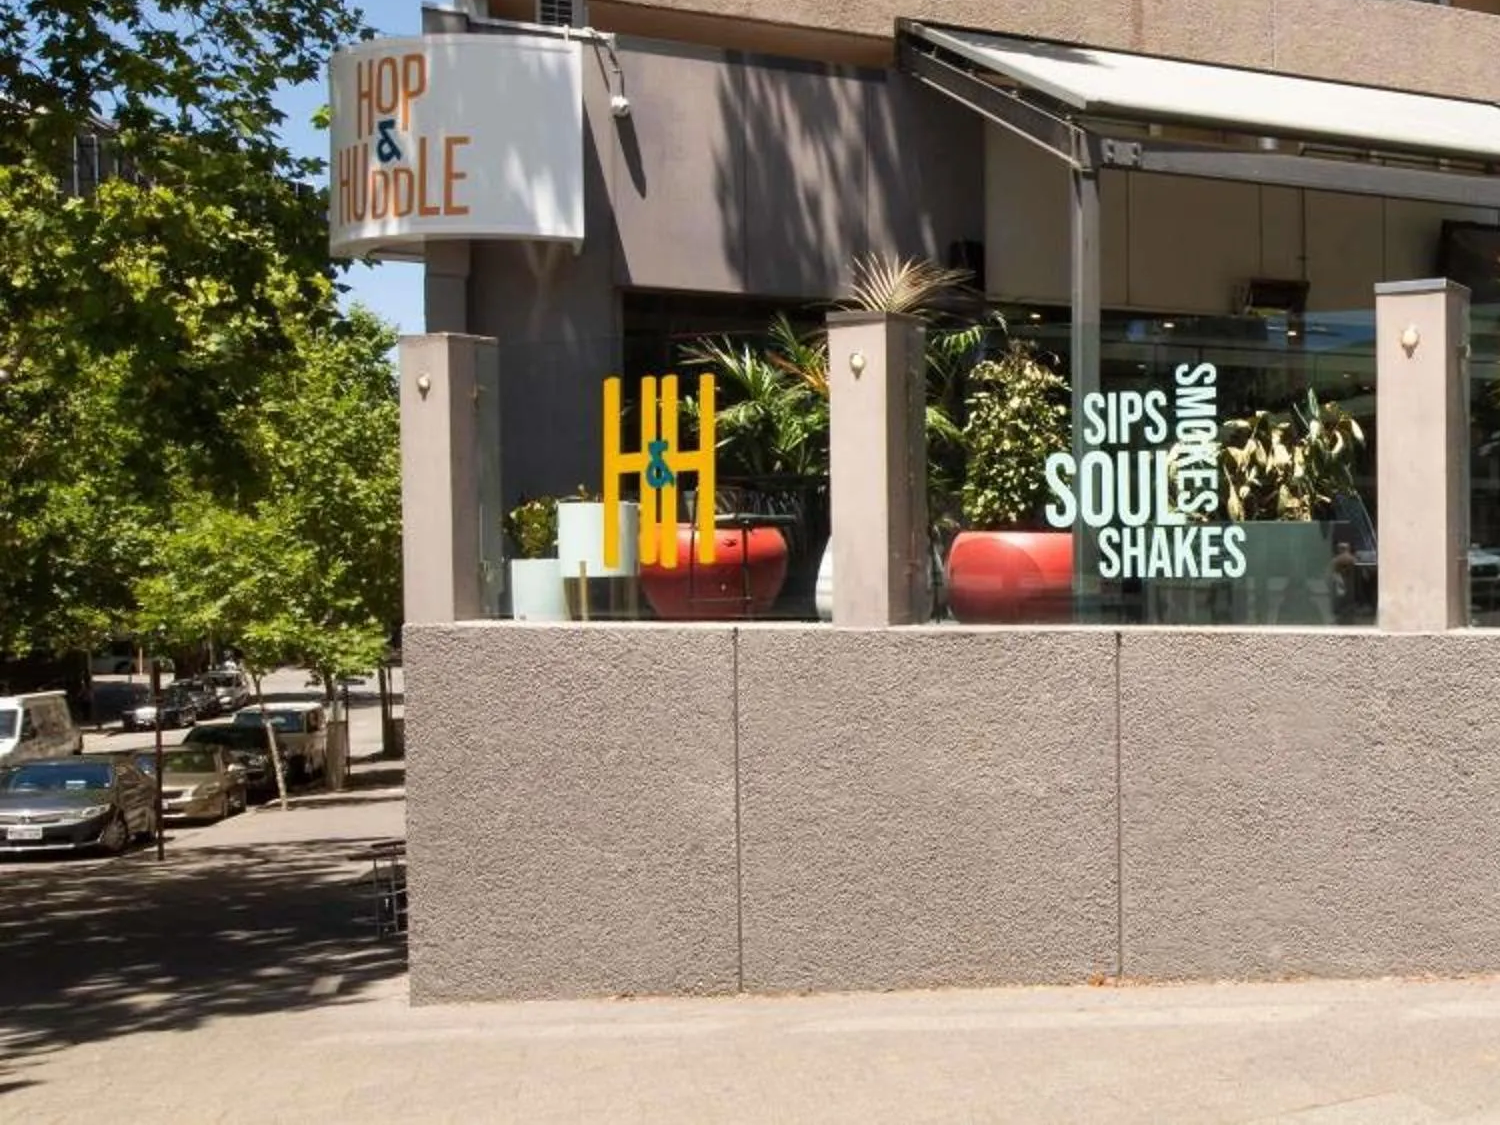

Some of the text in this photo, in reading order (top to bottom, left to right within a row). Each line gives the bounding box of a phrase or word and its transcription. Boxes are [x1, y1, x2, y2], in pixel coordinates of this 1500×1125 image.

[357, 53, 427, 140] HOP
[376, 119, 401, 163] &
[339, 136, 471, 226] HUDDLE
[1083, 391, 1168, 446] SIPS
[1174, 362, 1219, 514] SMOKES
[1045, 451, 1186, 528] SOUL
[1098, 525, 1247, 579] SHAKES
